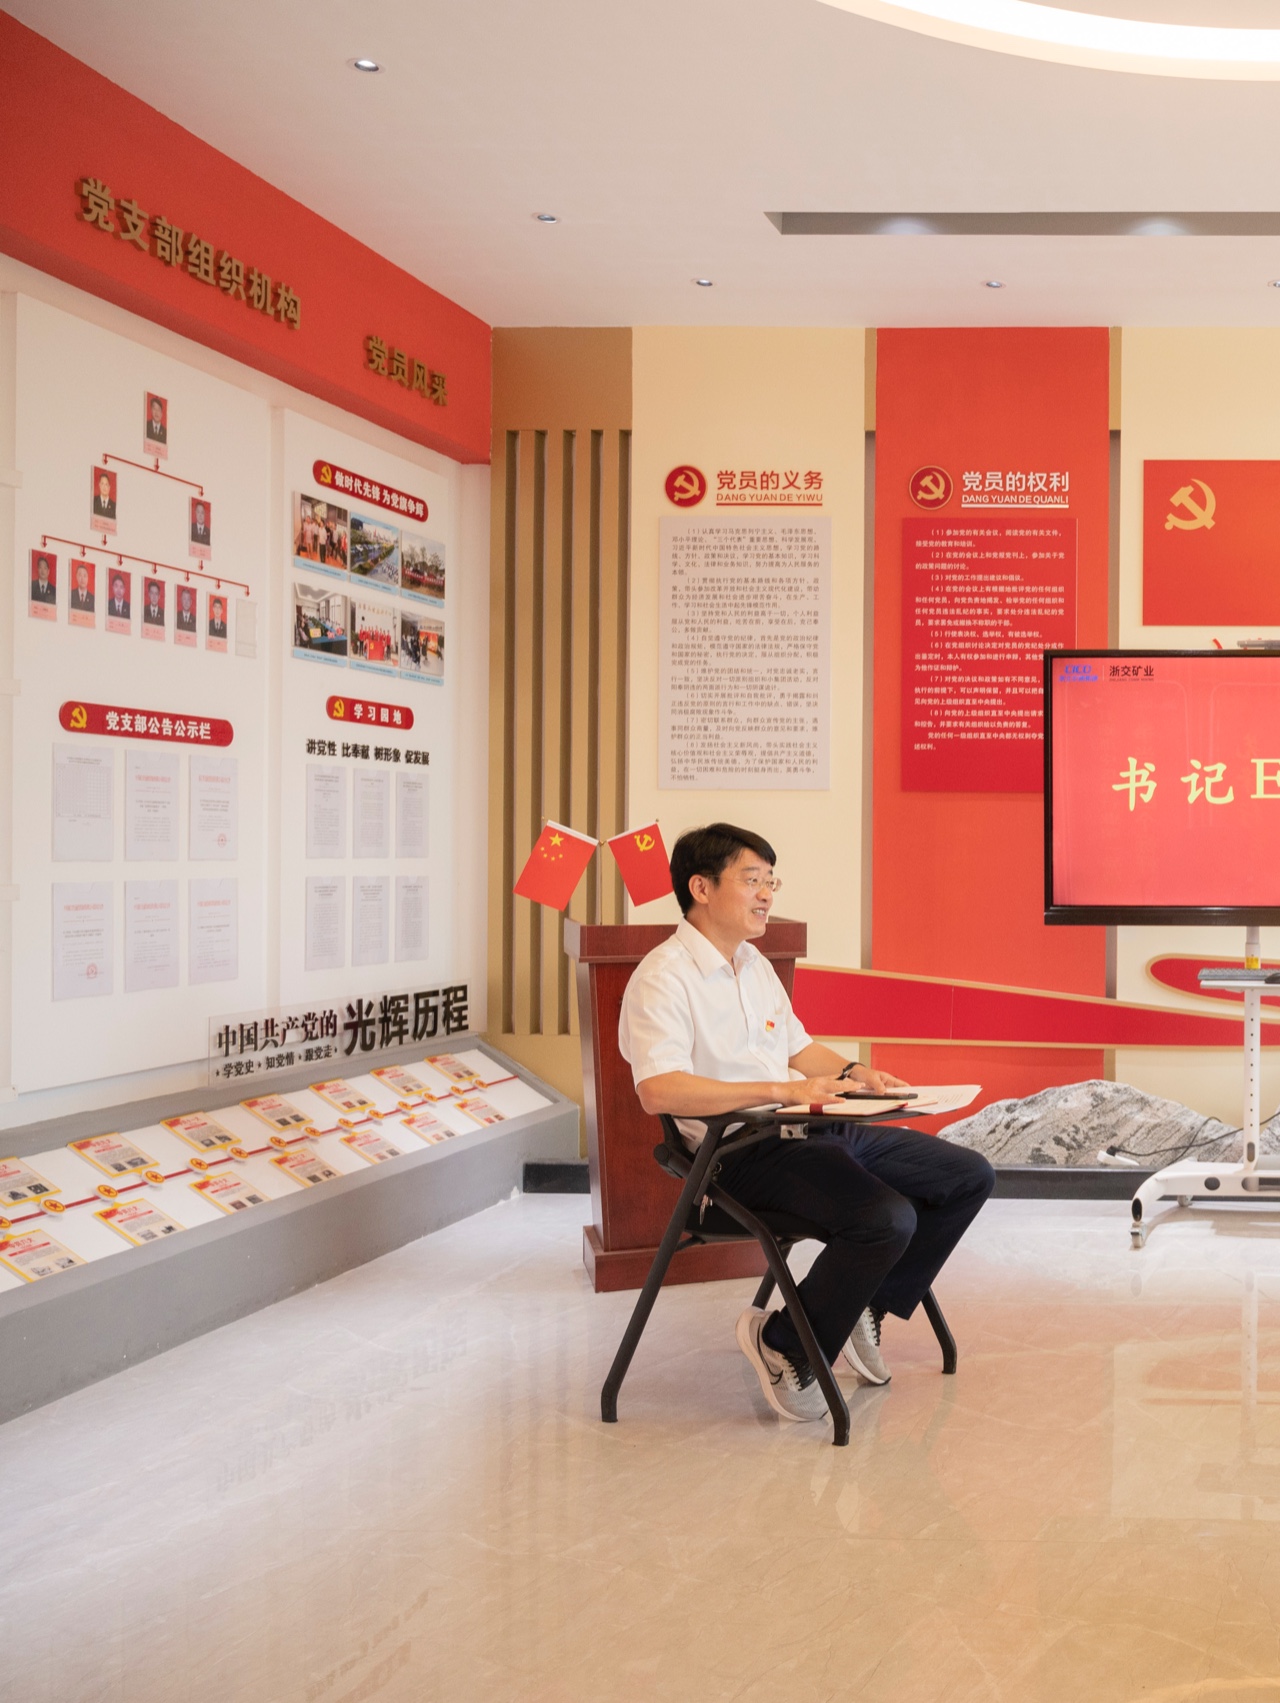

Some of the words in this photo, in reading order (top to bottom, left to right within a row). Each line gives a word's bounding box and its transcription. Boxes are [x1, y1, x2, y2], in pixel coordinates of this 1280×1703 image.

[80, 177, 301, 330] 党支部组织机构
[367, 336, 448, 406] 党员风采
[334, 470, 380, 501] 做时代先锋
[717, 470, 823, 490] 党员的义务
[963, 471, 1069, 492] 党员的权利
[717, 493, 746, 501] DANG
[749, 493, 777, 501] YUAN
[780, 493, 793, 501] DE
[796, 493, 822, 501] YIWU
[962, 495, 989, 503] DANG
[991, 495, 1017, 503] YUAN
[1019, 495, 1032, 503] DE
[1033, 495, 1068, 504] QUANLI
[1109, 665, 1154, 677] 浙交矿业
[353, 703, 402, 724] 学习园地
[105, 711, 211, 740] 党支部公告公示栏
[306, 738, 337, 756] 讲党性
[217, 1009, 338, 1057] 中国共产党的
[342, 984, 469, 1056] 光辉历程
